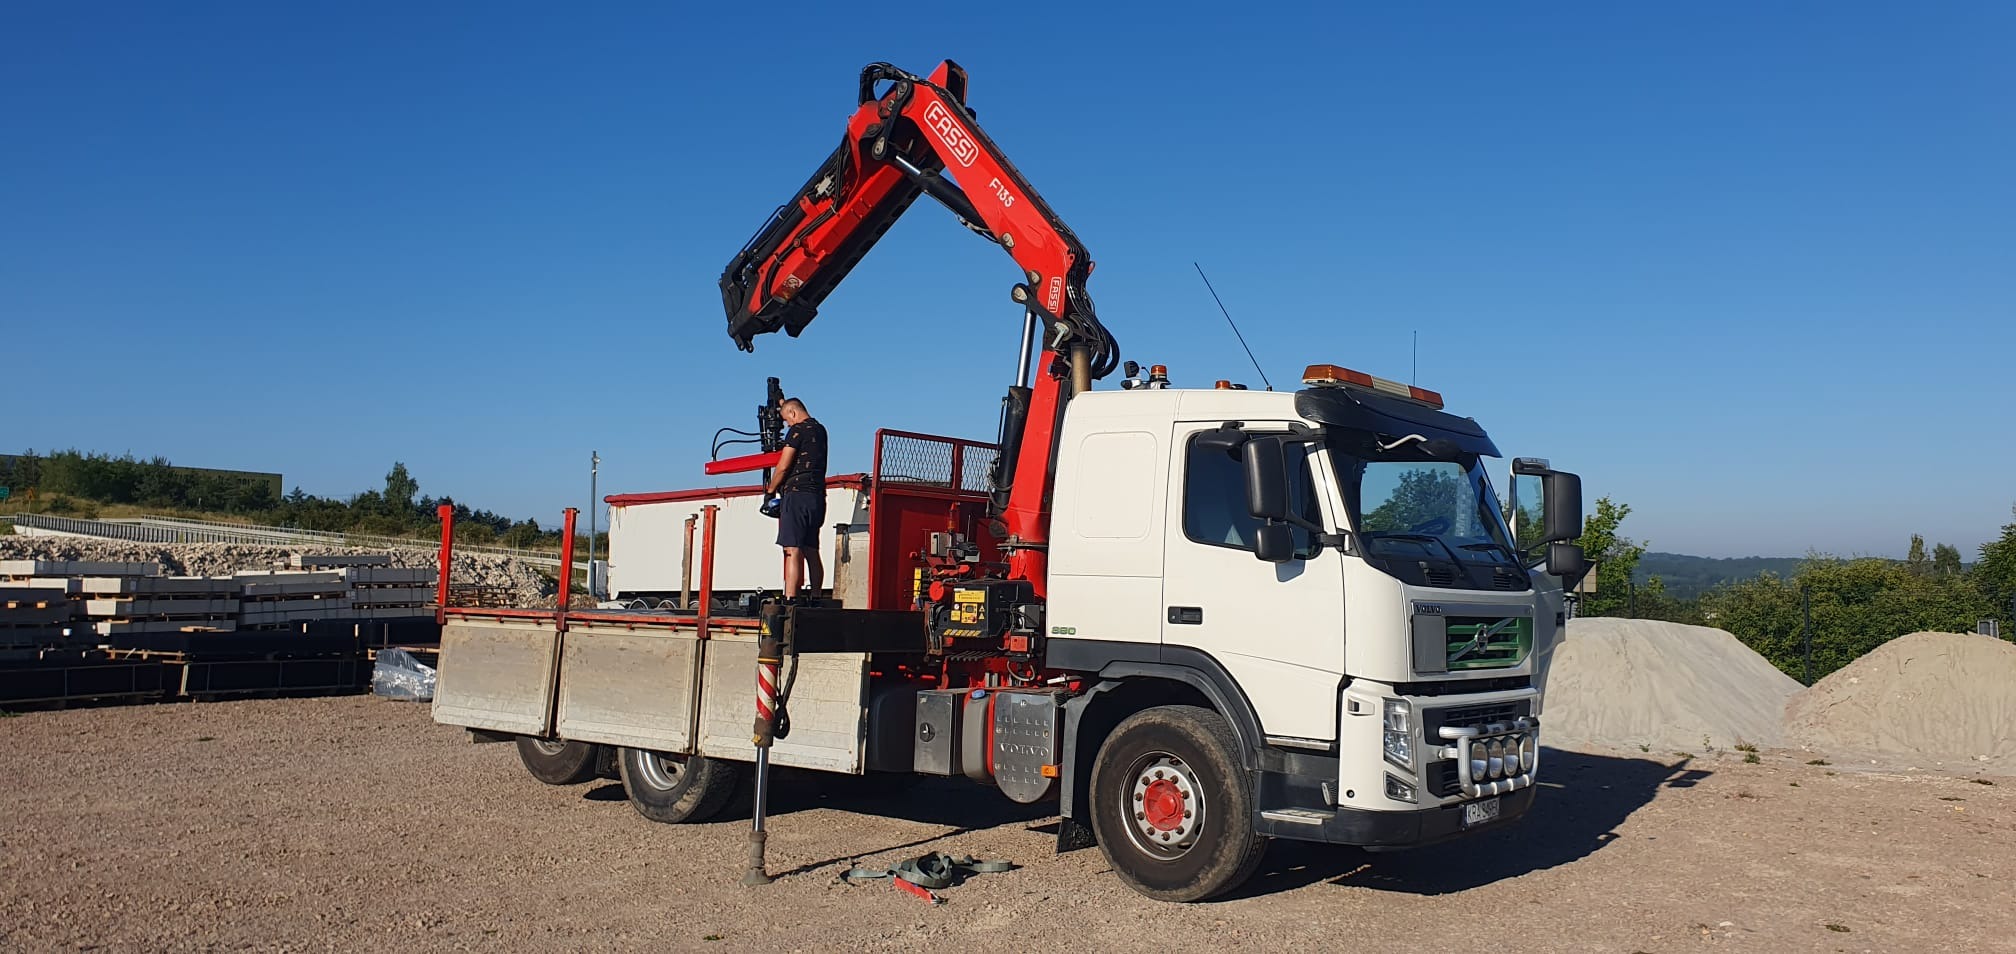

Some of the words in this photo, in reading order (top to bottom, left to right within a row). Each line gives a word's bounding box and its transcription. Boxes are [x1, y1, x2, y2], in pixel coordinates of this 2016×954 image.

[927, 105, 975, 162] FASSI
[988, 177, 1015, 208] F135
[1050, 279, 1060, 310] FASSI
[1415, 603, 1441, 614] VOLVO
[998, 743, 1049, 757] VOLVO
